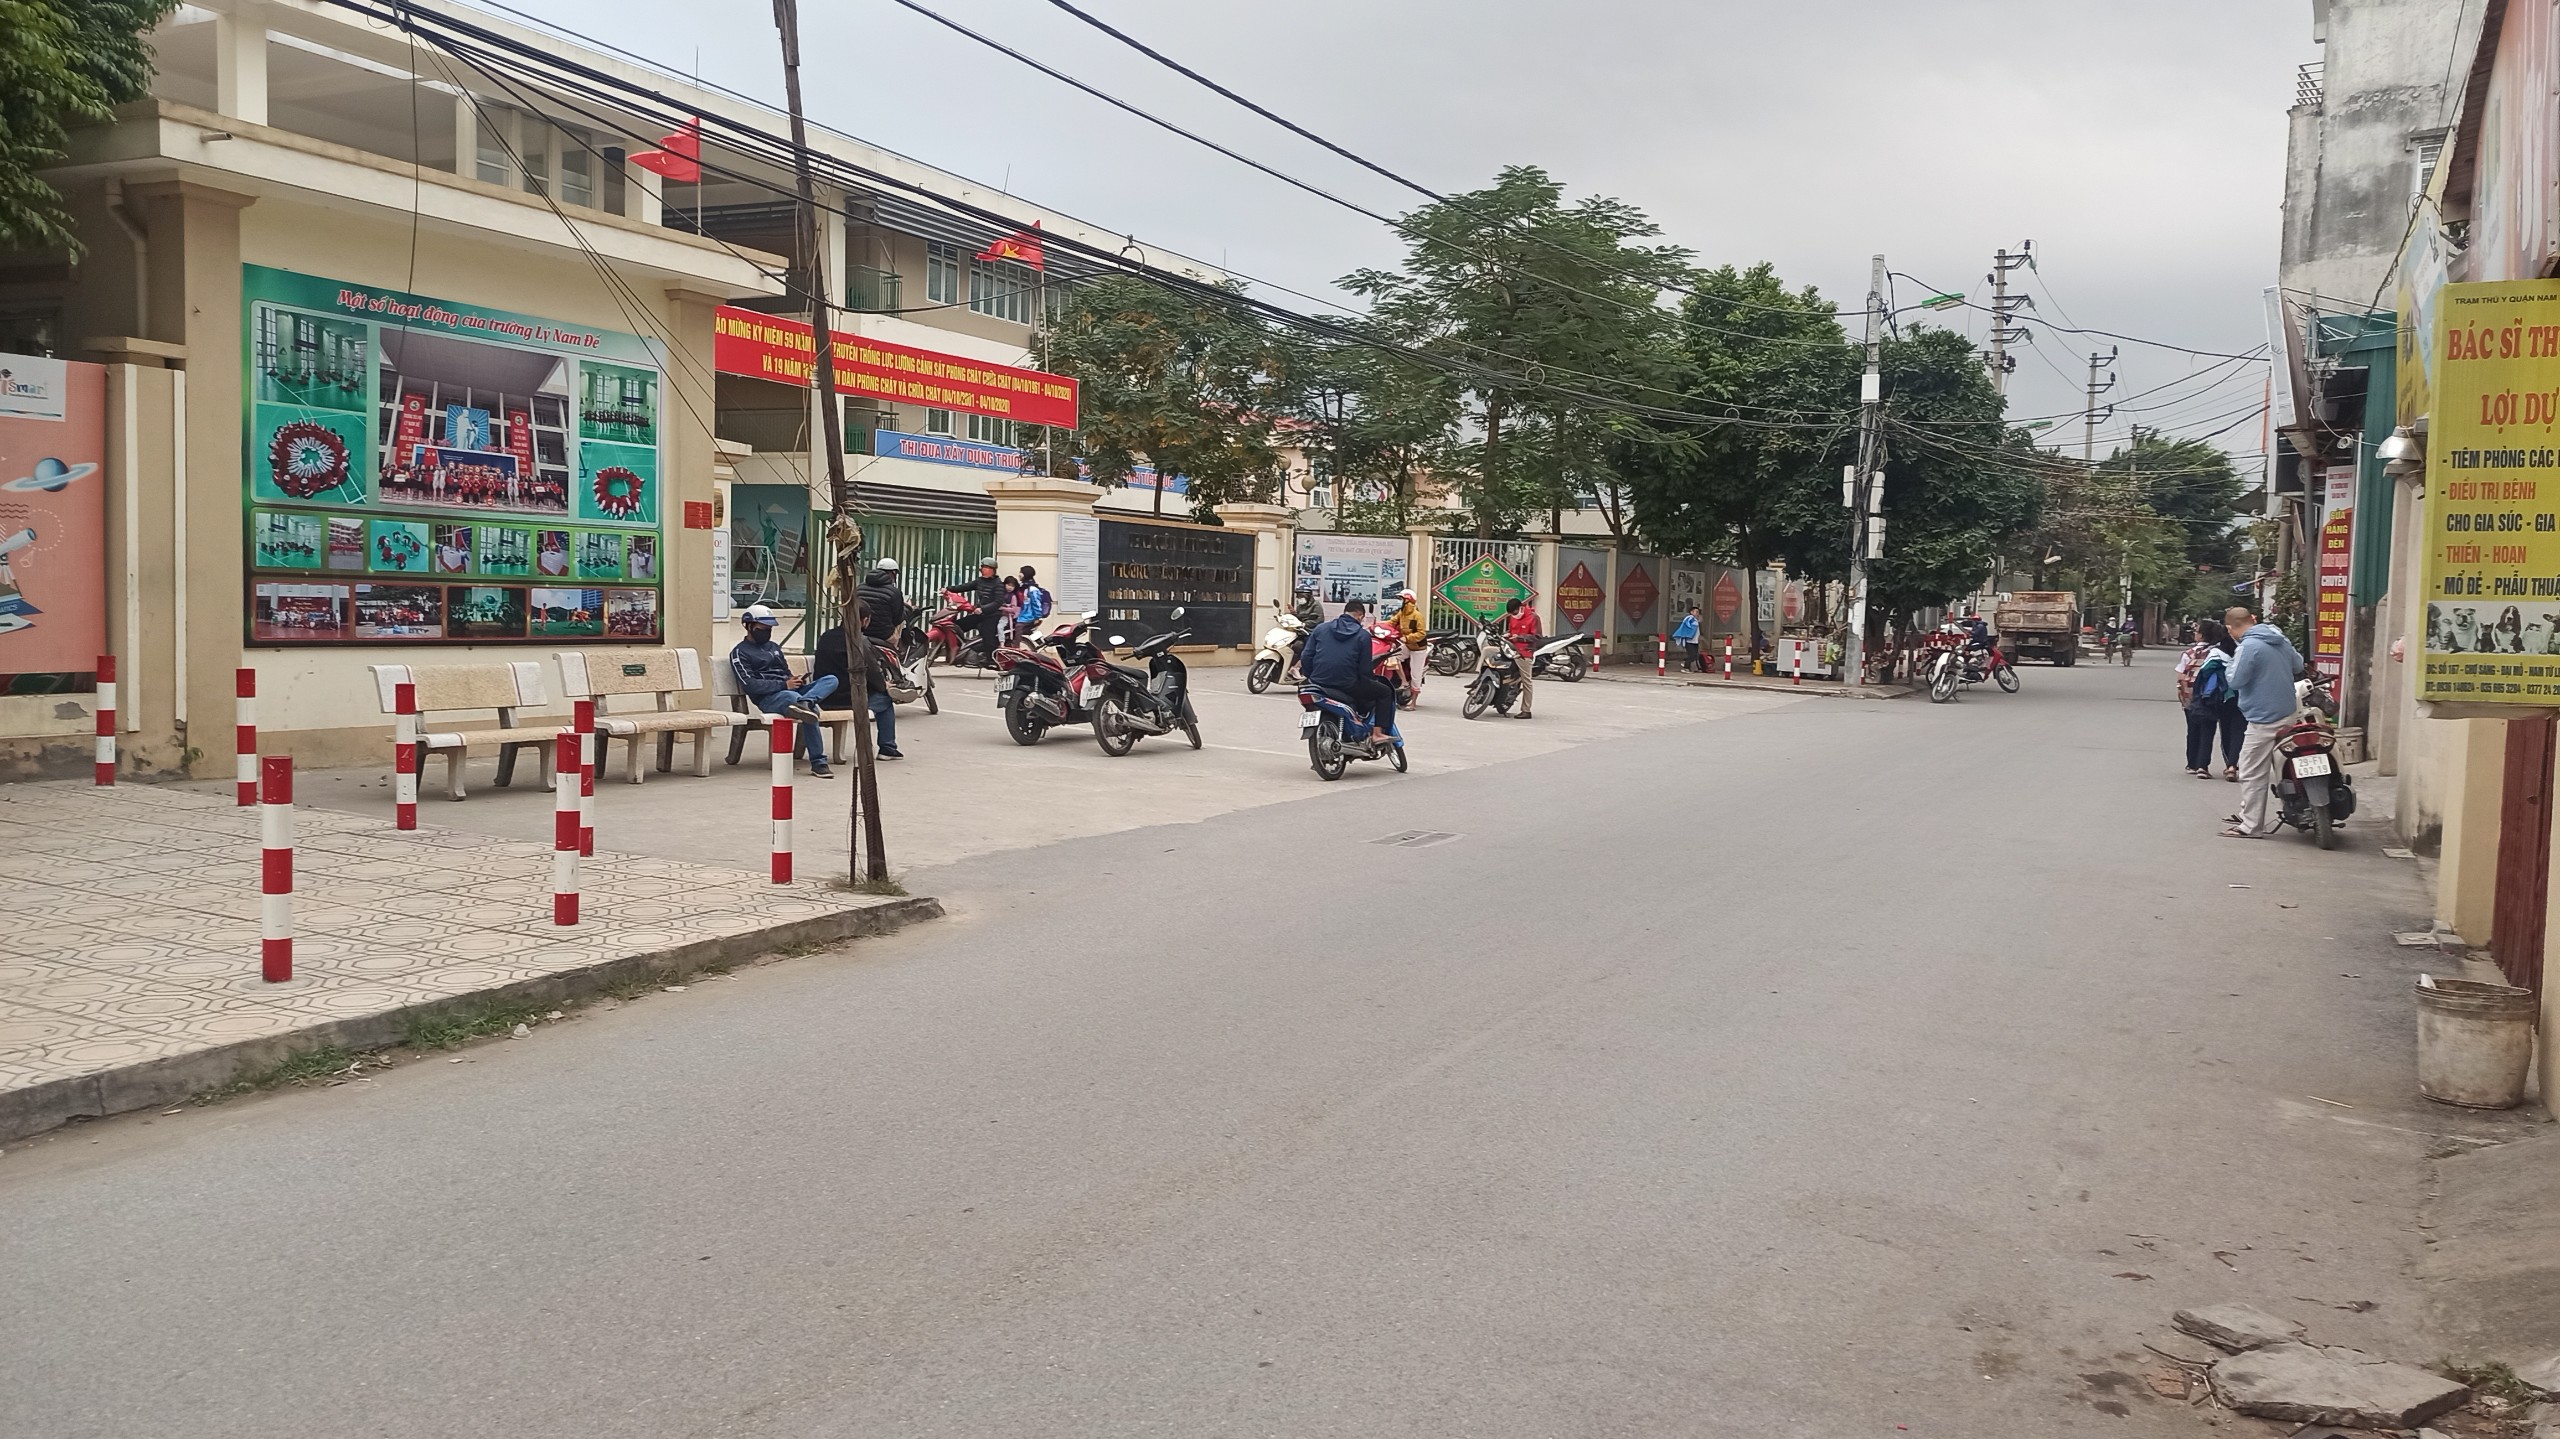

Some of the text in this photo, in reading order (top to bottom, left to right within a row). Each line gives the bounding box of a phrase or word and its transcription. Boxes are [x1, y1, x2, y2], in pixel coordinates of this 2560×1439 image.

[2455, 297, 2479, 305] TRẠM
[2509, 295, 2535, 304] QUẬN
[338, 290, 366, 313] Một
[369, 295, 388, 312] số
[388, 300, 422, 322] hoạt
[423, 305, 458, 328] động
[461, 312, 486, 330] của
[489, 318, 533, 341] trường
[535, 325, 551, 344] Lý
[552, 328, 581, 346] Nam
[715, 313, 726, 334] ÀO
[728, 317, 751, 339] MỪNG
[764, 326, 783, 349] NIỆM
[784, 332, 794, 348] 59
[859, 344, 880, 367] THỐNG
[881, 351, 894, 371] LỰC
[894, 352, 915, 374] LƯỢNG
[916, 354, 933, 376] CẢNH
[934, 359, 945, 378] SÁT
[945, 362, 966, 382] PHÒNG
[966, 366, 982, 384] CHÁY
[2447, 319, 2494, 360] BÁC
[2499, 317, 2523, 359] SĨ
[762, 352, 773, 373] VÀ
[774, 357, 783, 374] 19
[784, 357, 801, 378] NĂM
[841, 368, 856, 387] DÂN
[857, 371, 880, 392] PHÒNG
[880, 376, 897, 395] CHÁY
[898, 378, 907, 396] VÀ
[925, 384, 941, 402] CHÁY
[2480, 388, 2519, 434] LỢI
[900, 439, 918, 457] THI
[920, 440, 942, 459] ĐUA
[943, 443, 965, 462] XÂY
[966, 447, 993, 467] DỰNG
[2451, 445, 2554, 469] TIÊM PHÒNG CÁC
[2449, 476, 2536, 504] ĐIỀU TRỊ BỆNH
[2446, 509, 2556, 532] CHO GIA SÚC GIA
[2446, 540, 2526, 567] THIẾN HOẠN
[2444, 569, 2465, 595] MỔ
[2467, 570, 2483, 595] ĐẺ
[2494, 570, 2528, 596] PHẪU
